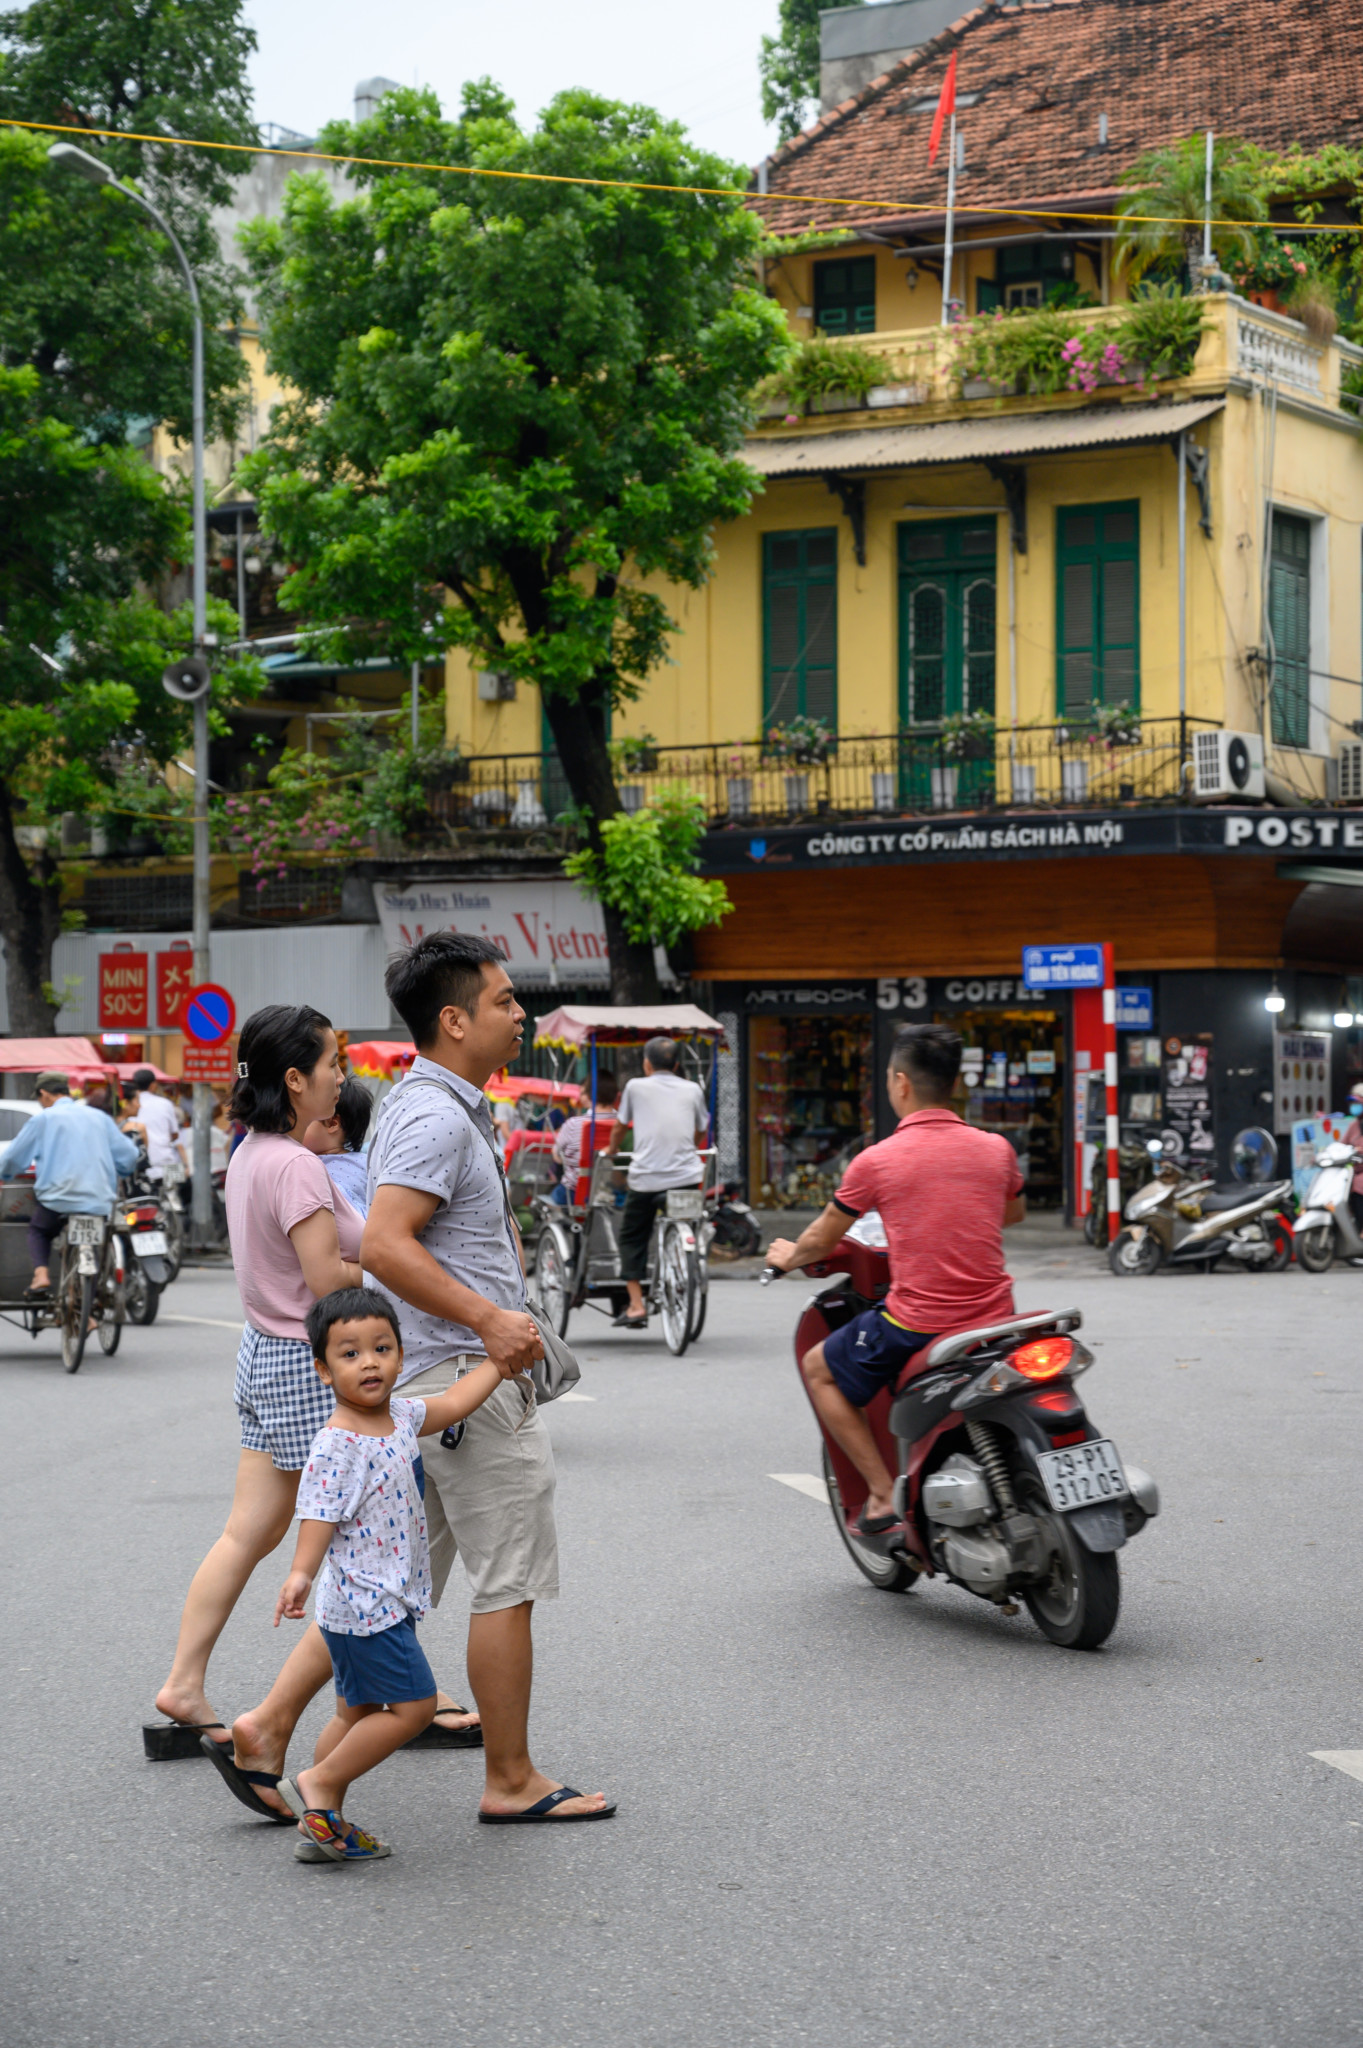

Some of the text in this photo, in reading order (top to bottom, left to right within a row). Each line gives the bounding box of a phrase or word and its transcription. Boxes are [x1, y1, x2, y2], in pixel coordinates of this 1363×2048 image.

[807, 832, 865, 856] CÔNG
[868, 834, 896, 853] TY
[990, 824, 1048, 848] SÁCH
[1050, 822, 1080, 845] HÀ
[1084, 820, 1123, 848] NỘI
[420, 892, 448, 911] Huy
[103, 968, 144, 988] MINI
[876, 976, 928, 1010] 53
[746, 985, 867, 1005] ARTBOOK
[1051, 1446, 1109, 1479] 29-P1
[1053, 1469, 1125, 1506] 312.05
